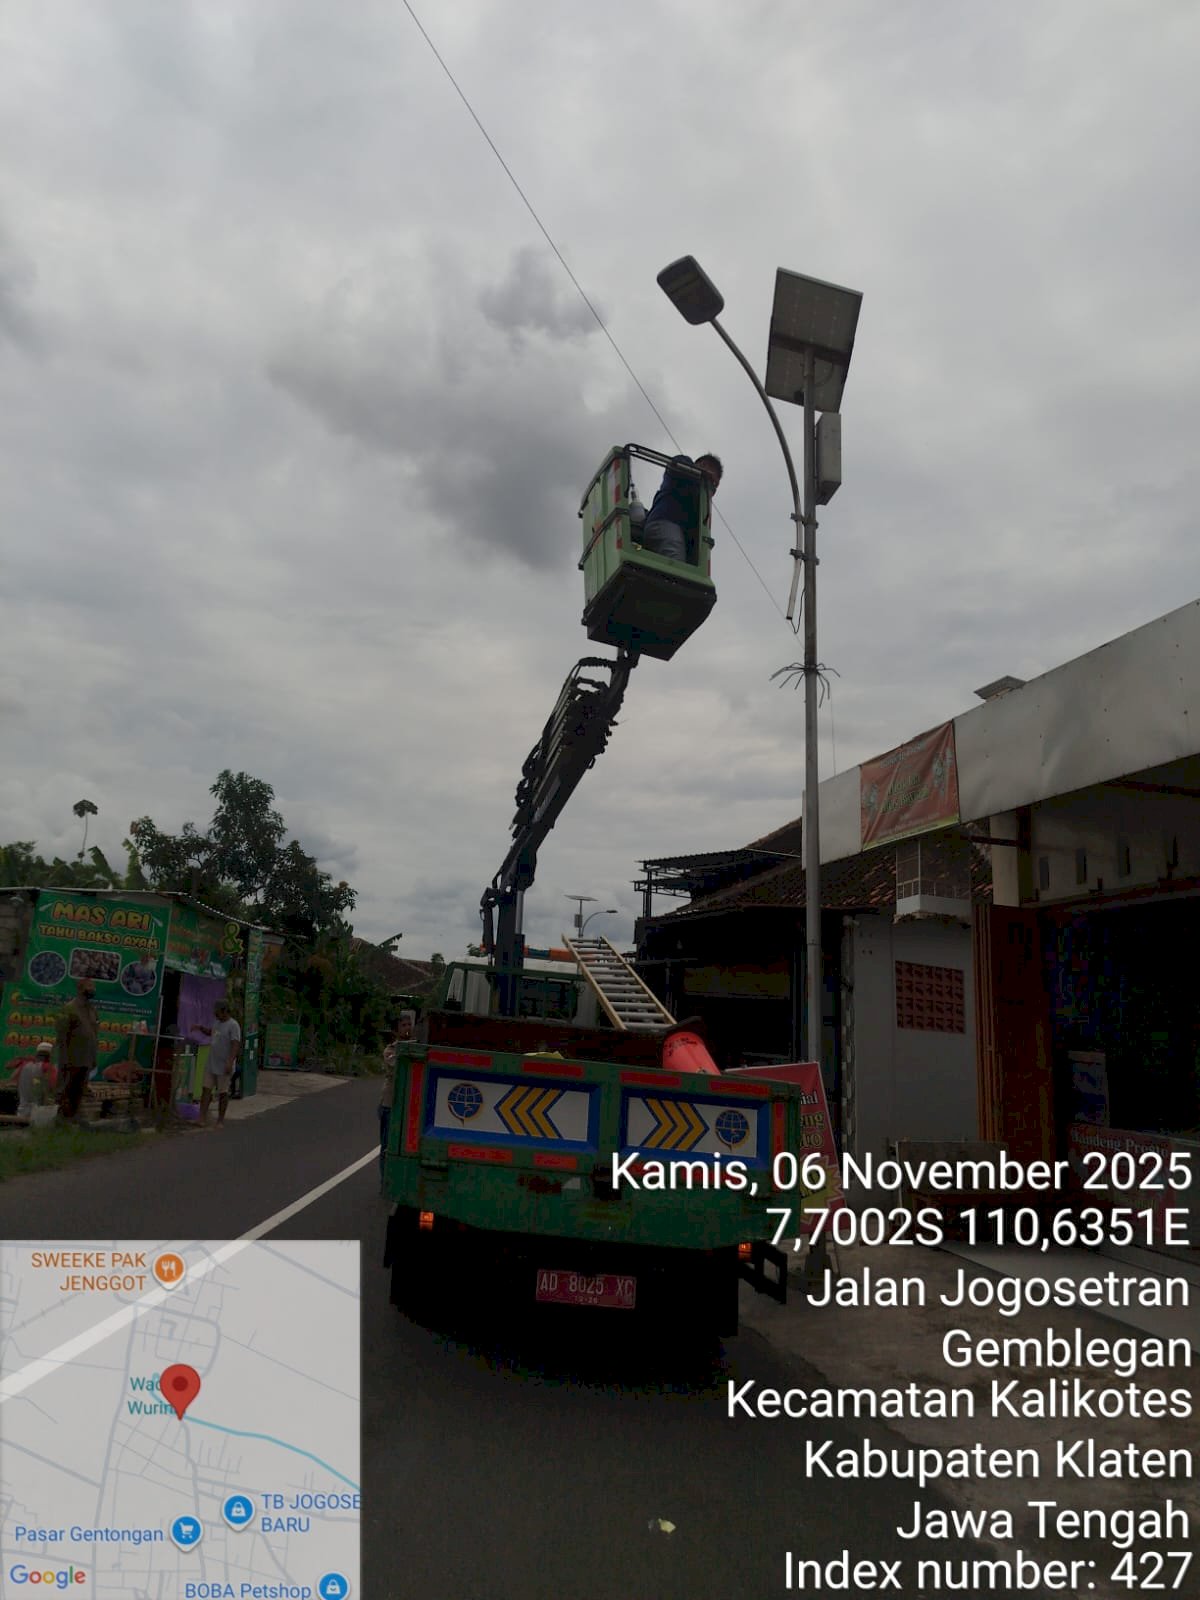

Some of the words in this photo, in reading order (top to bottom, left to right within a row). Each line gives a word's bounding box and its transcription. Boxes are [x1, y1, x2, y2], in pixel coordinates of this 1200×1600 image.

[52, 901, 107, 926] MAS
[109, 909, 152, 931] ARI
[39, 924, 74, 938] TAHU
[77, 928, 121, 945] BAKSO
[123, 935, 160, 949] AYAM
[540, 1272, 558, 1291] AD
[569, 1275, 604, 1295] 8025
